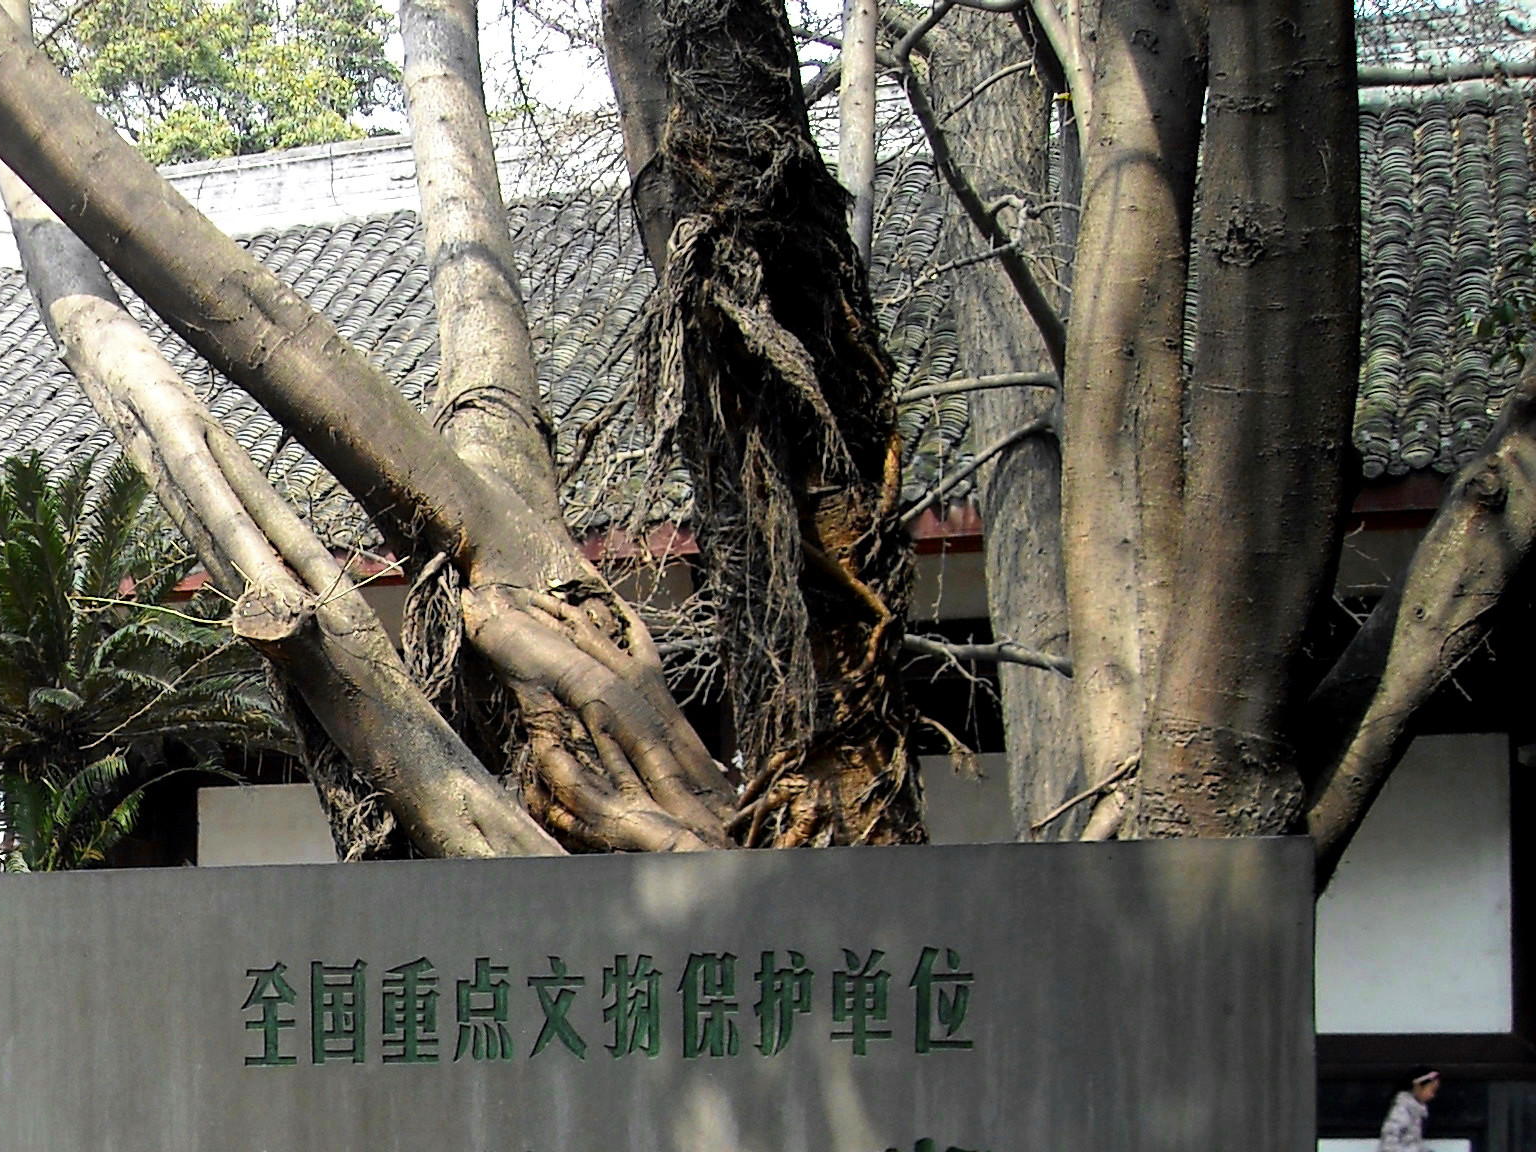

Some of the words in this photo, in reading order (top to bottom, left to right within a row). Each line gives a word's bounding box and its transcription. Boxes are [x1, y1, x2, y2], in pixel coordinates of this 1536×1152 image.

[240, 945, 975, 1067] 全国重点文物保护单位
